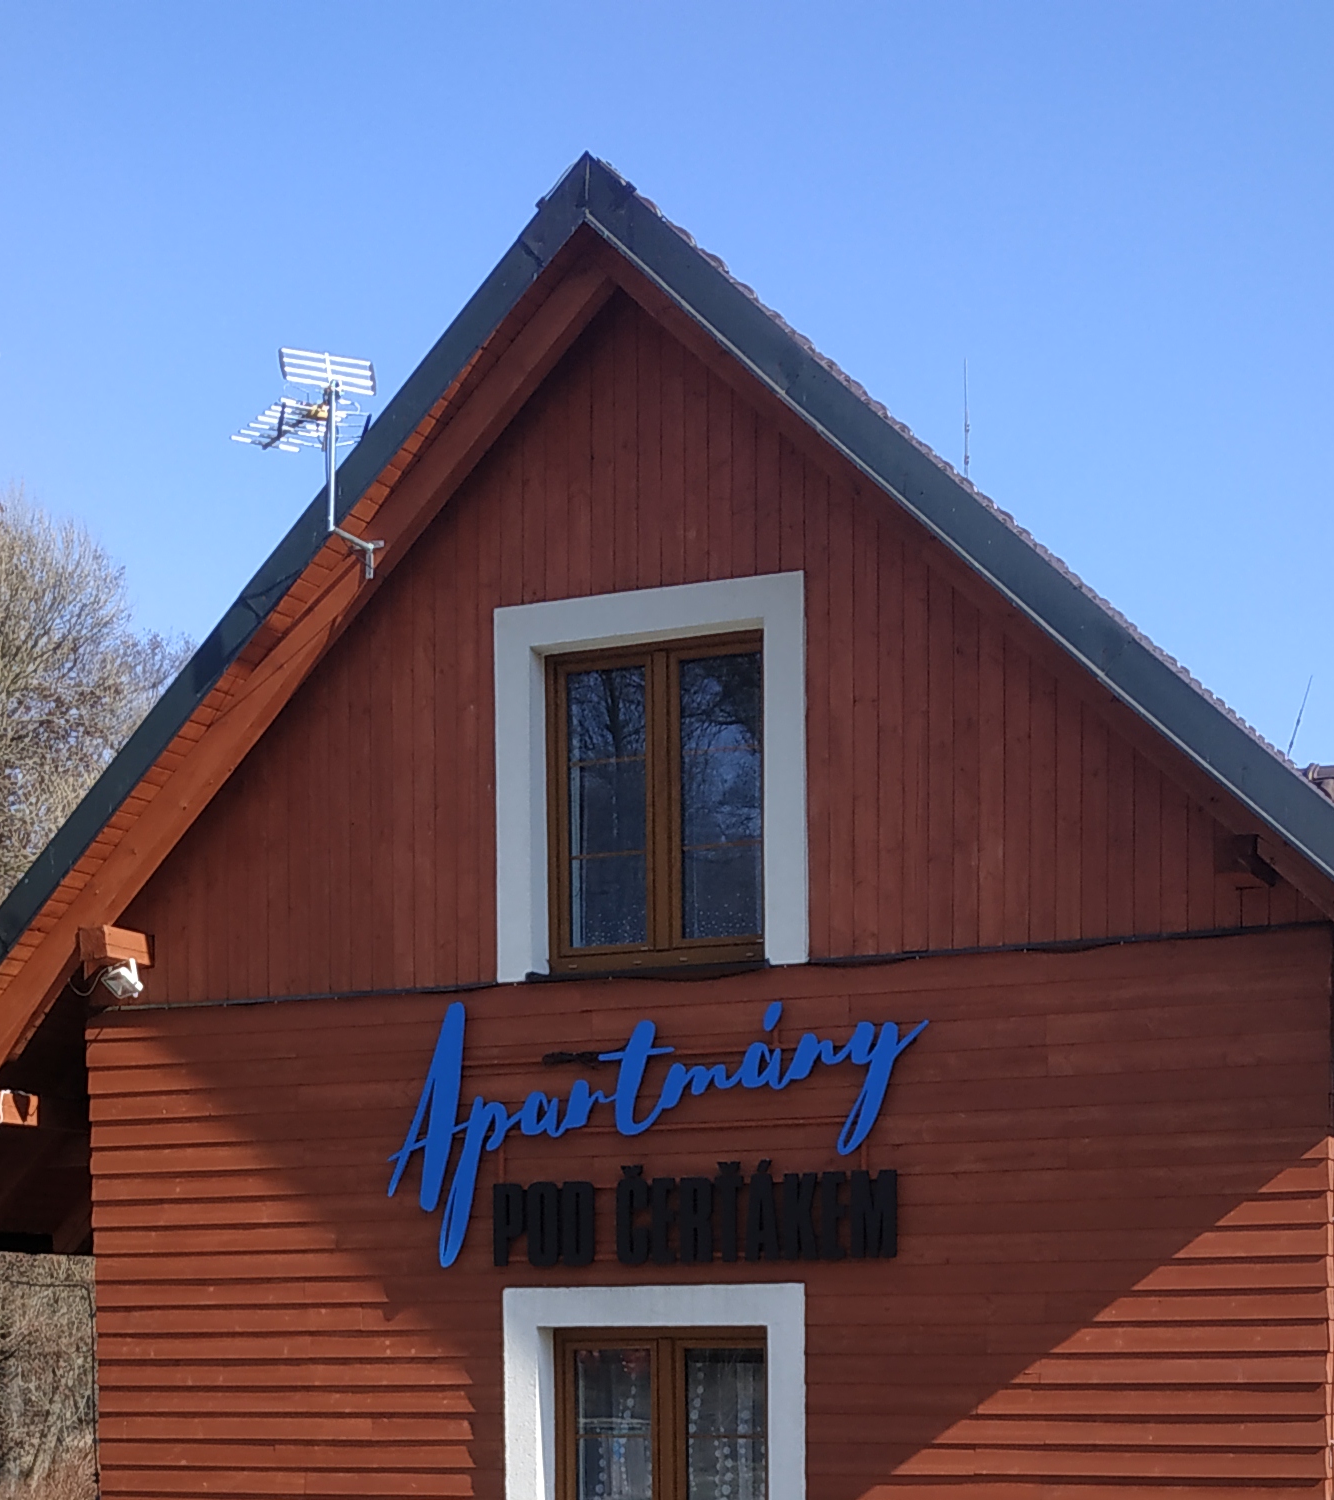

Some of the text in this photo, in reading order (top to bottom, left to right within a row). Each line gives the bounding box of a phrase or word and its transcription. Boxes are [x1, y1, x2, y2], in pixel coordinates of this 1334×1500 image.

[387, 1002, 929, 1268] Apartmány
[492, 1160, 898, 1267] POD ČERŤÁKEM
